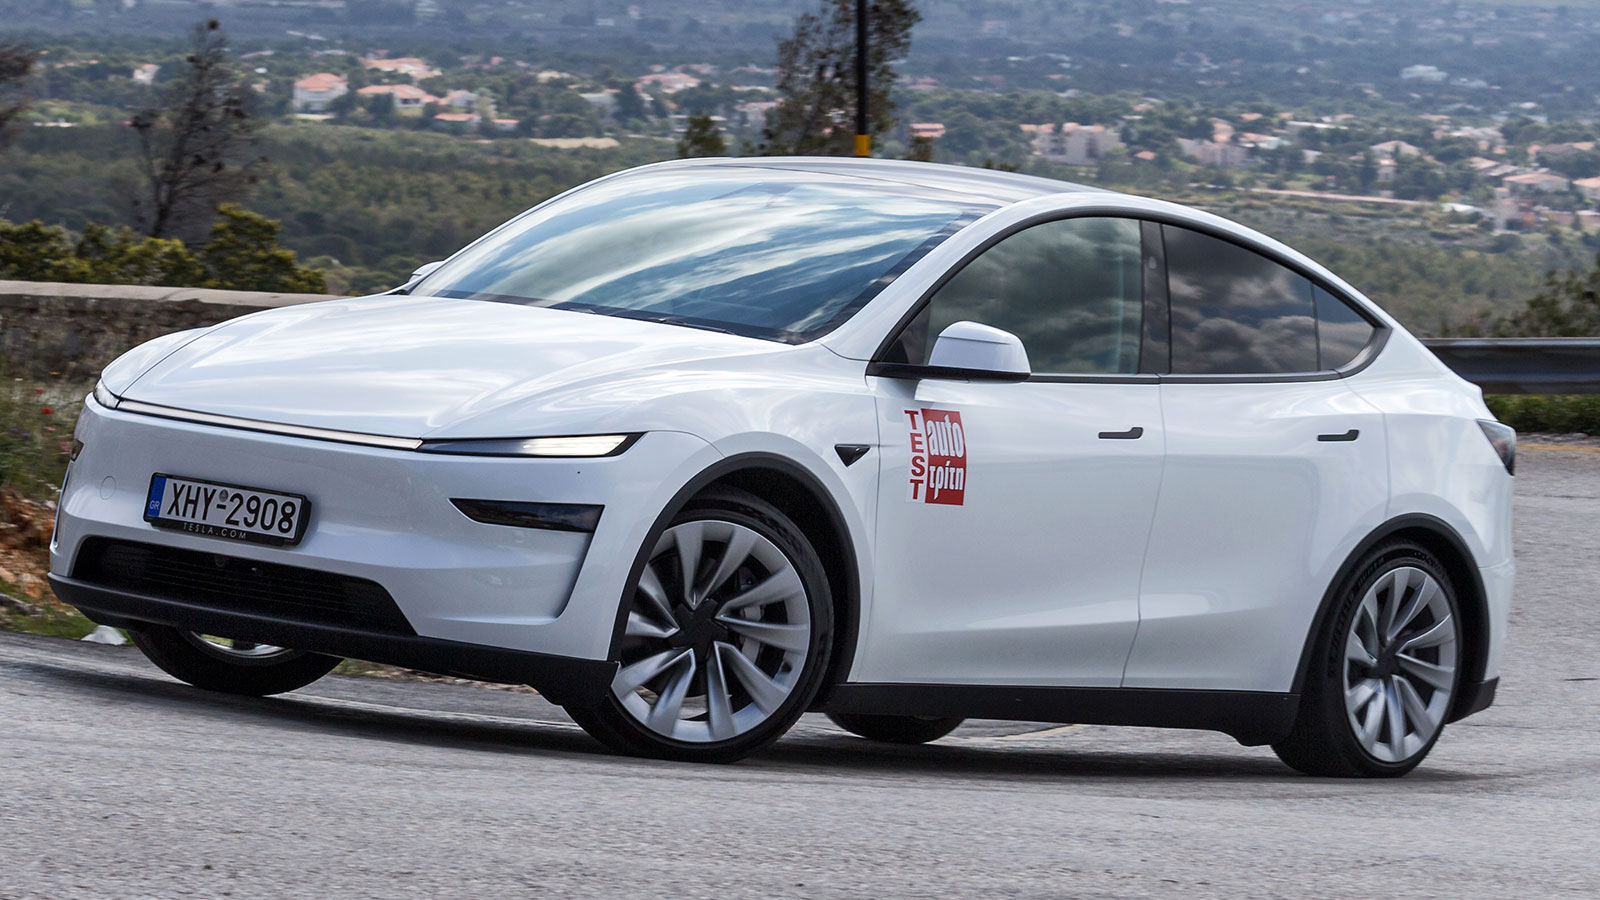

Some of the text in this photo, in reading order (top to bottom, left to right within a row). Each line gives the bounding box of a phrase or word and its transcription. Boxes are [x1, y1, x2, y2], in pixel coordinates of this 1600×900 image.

[926, 413, 965, 458] auto
[904, 409, 926, 500] TEST
[149, 499, 160, 511] GR
[182, 522, 247, 540] TESLA.COM
